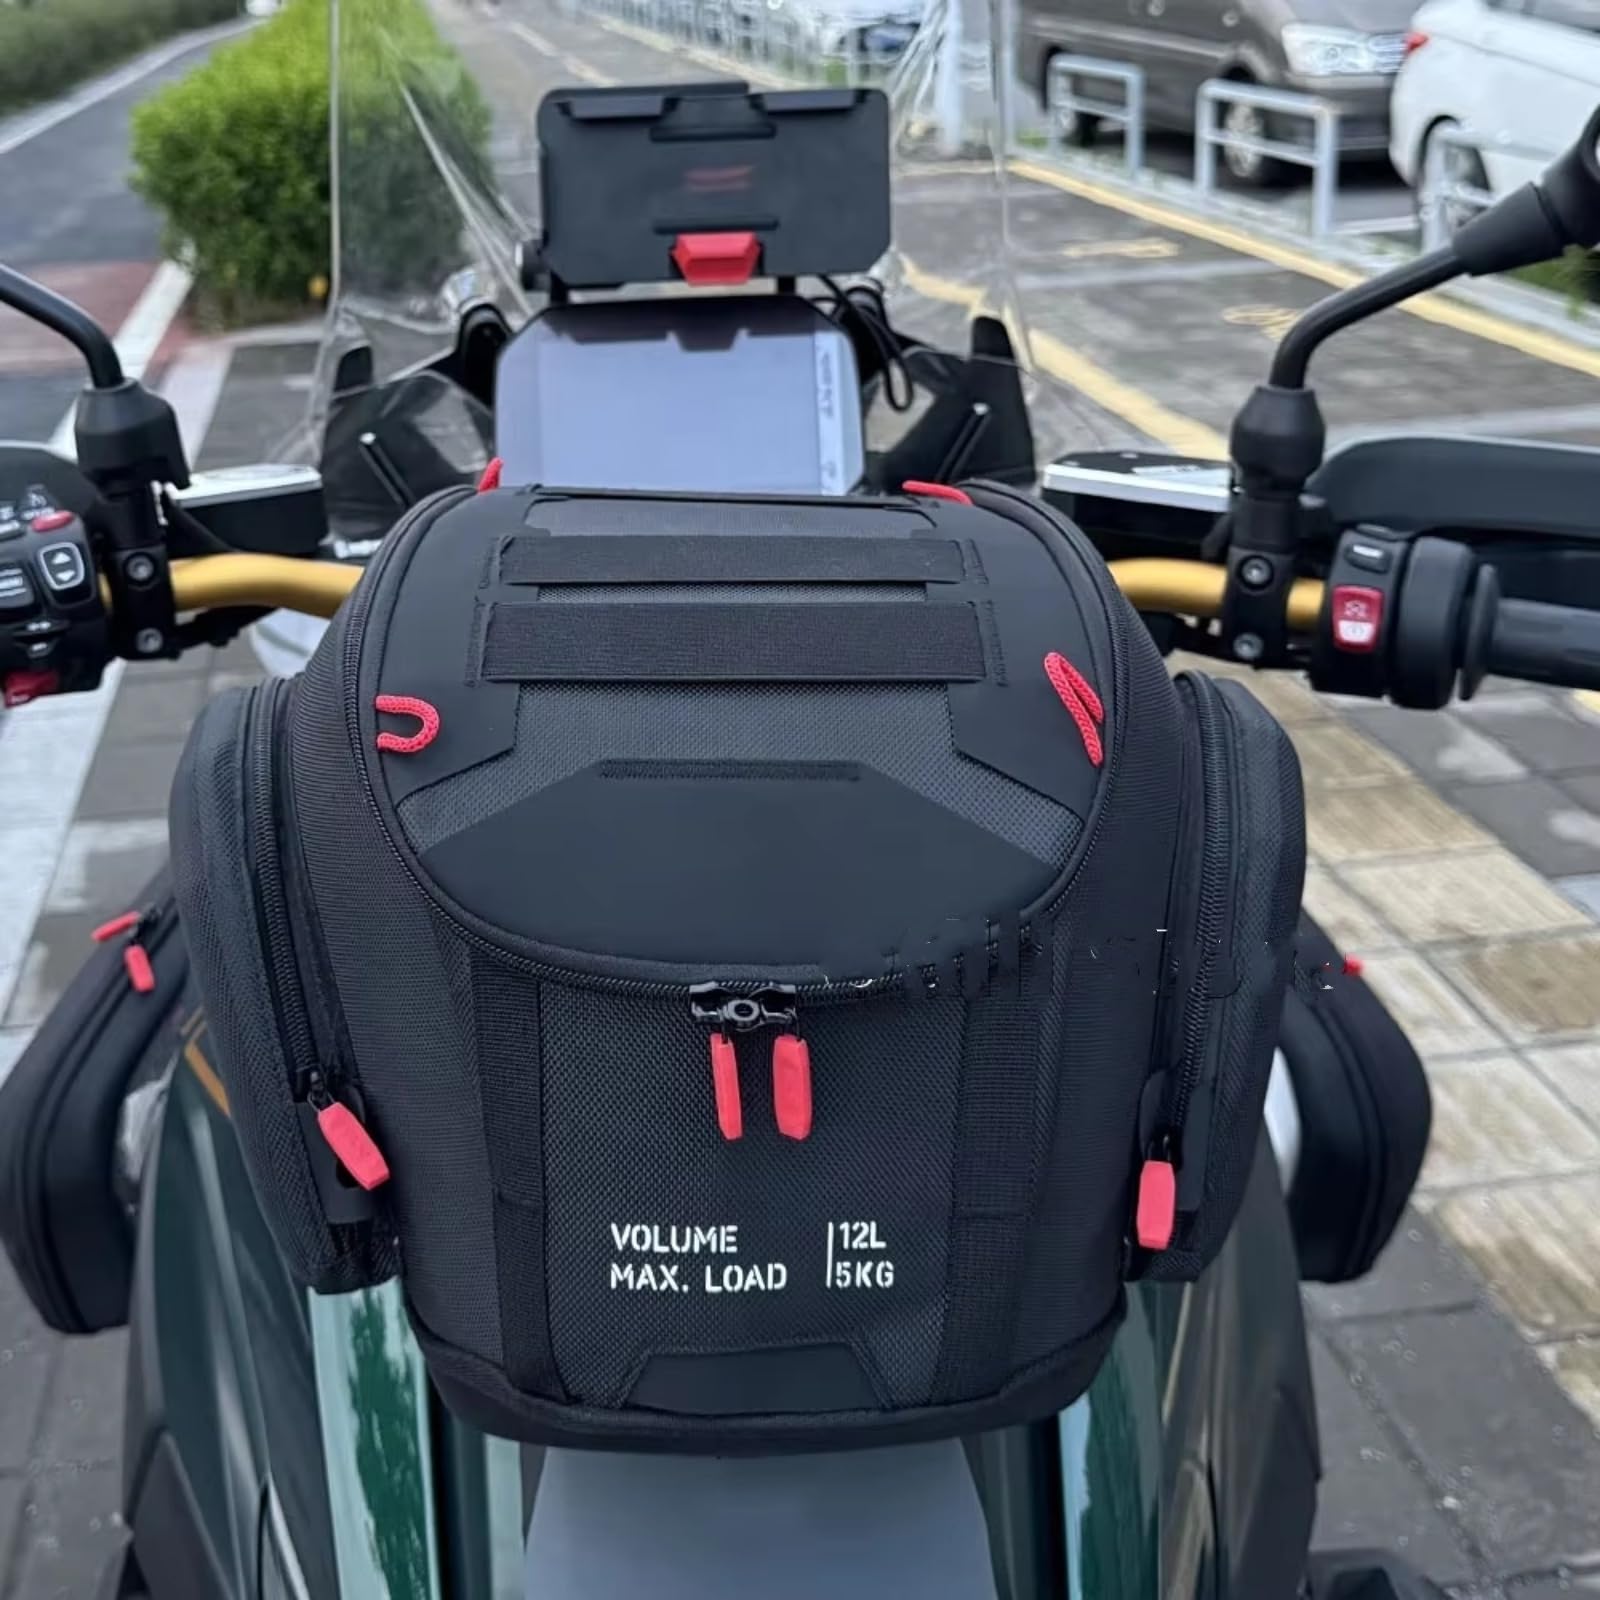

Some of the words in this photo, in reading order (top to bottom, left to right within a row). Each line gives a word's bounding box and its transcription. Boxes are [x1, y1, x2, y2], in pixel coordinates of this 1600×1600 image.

[610, 1222, 738, 1254] VOLUME
[839, 1220, 887, 1250] 12L
[610, 1262, 689, 1293] MAX.
[705, 1262, 788, 1293] LOAD
[836, 1260, 894, 1288] 5KG
